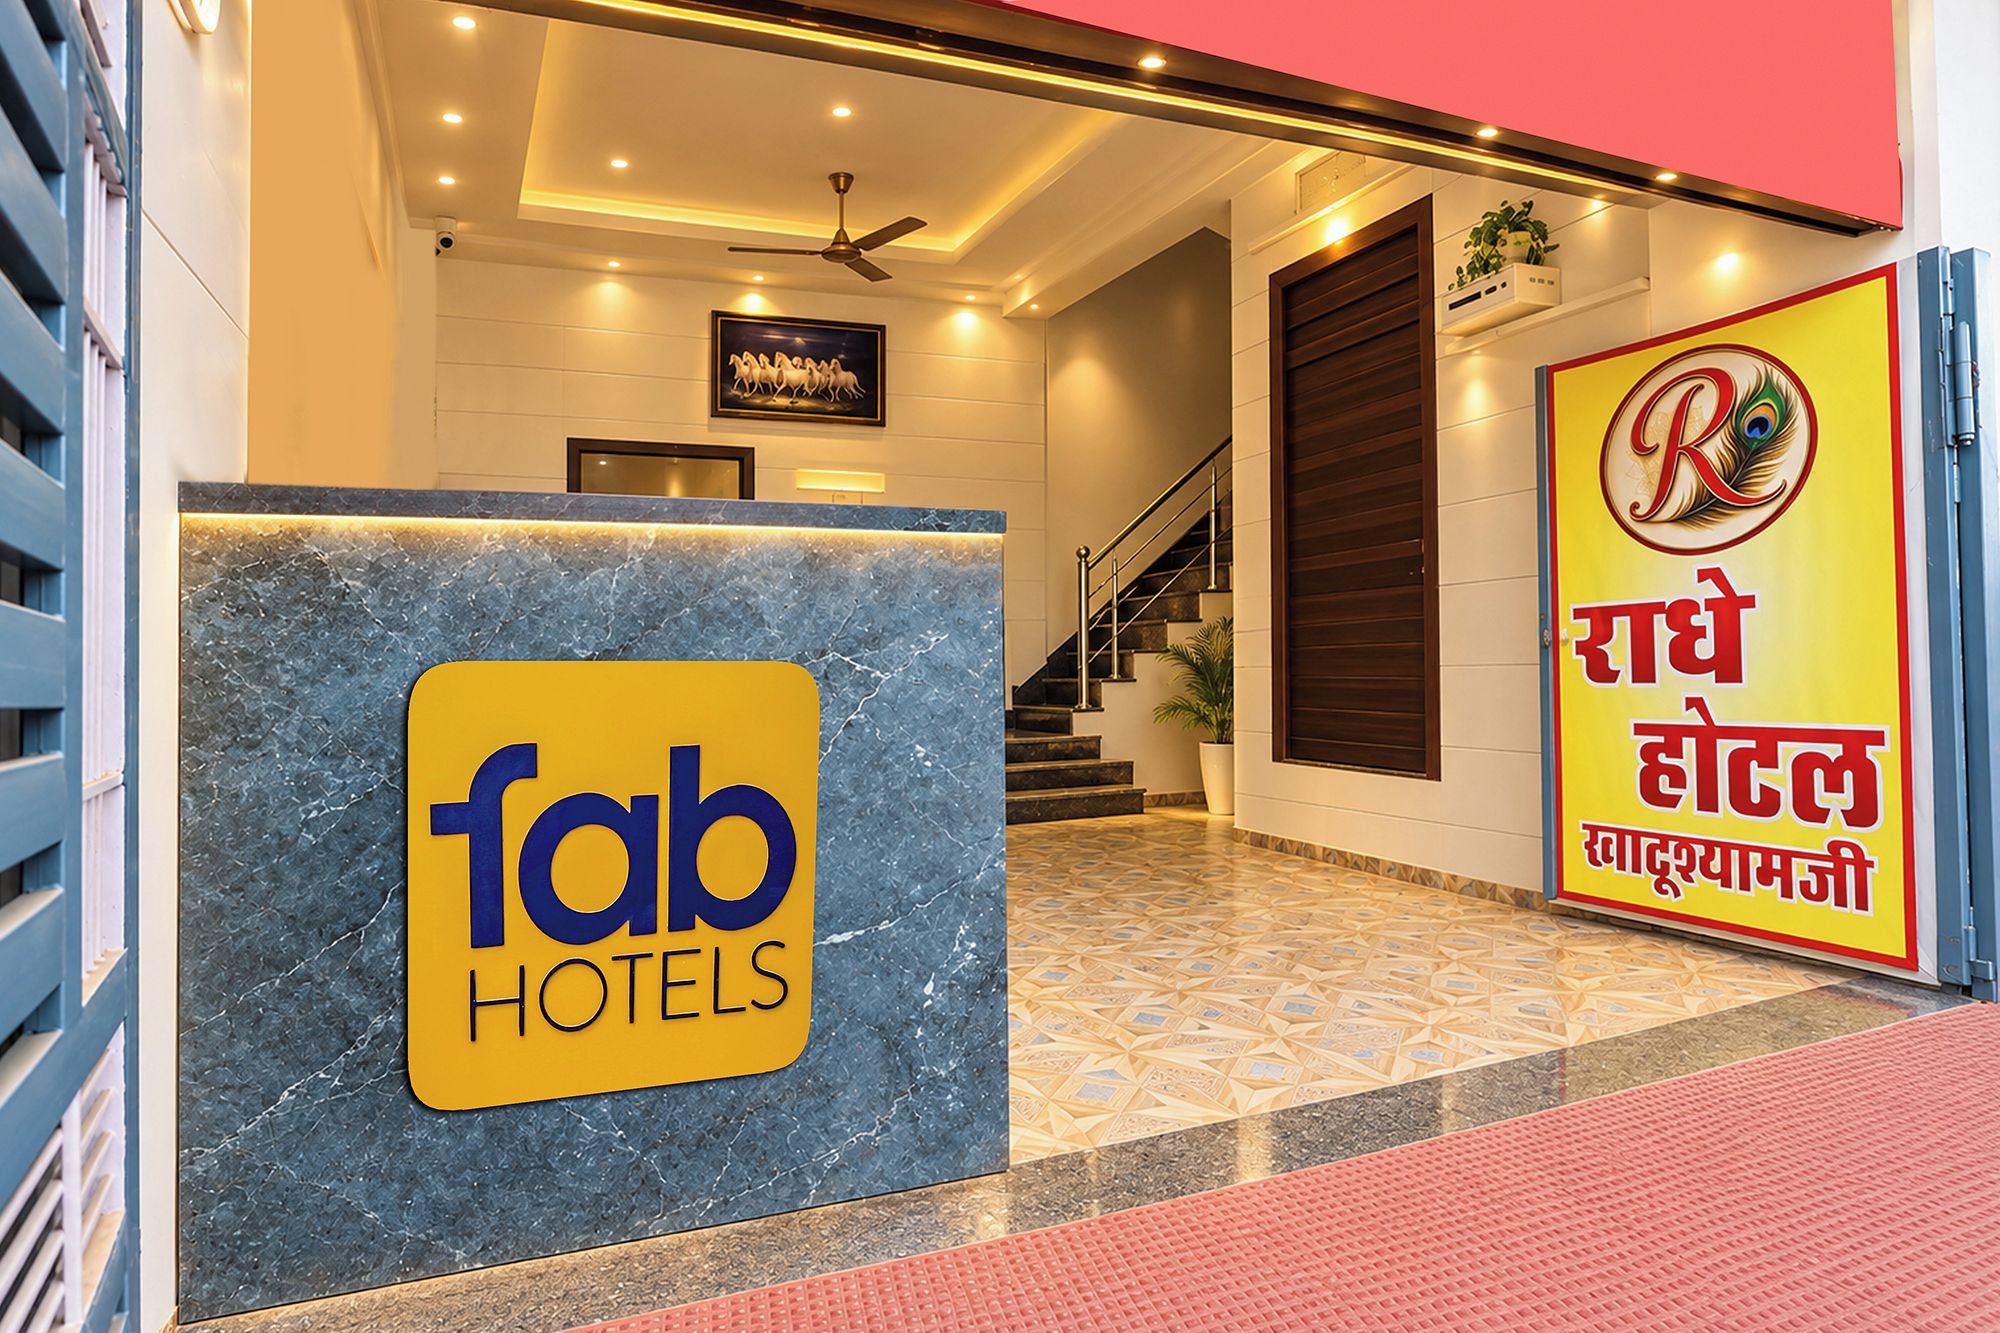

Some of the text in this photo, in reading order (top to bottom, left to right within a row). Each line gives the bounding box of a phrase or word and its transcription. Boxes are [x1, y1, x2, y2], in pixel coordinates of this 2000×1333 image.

[1630, 367, 1788, 523] R
[1573, 567, 1756, 684] राधे
[1633, 697, 1886, 829] होटल
[430, 743, 797, 948] fab
[470, 941, 789, 1041] HOTELS
